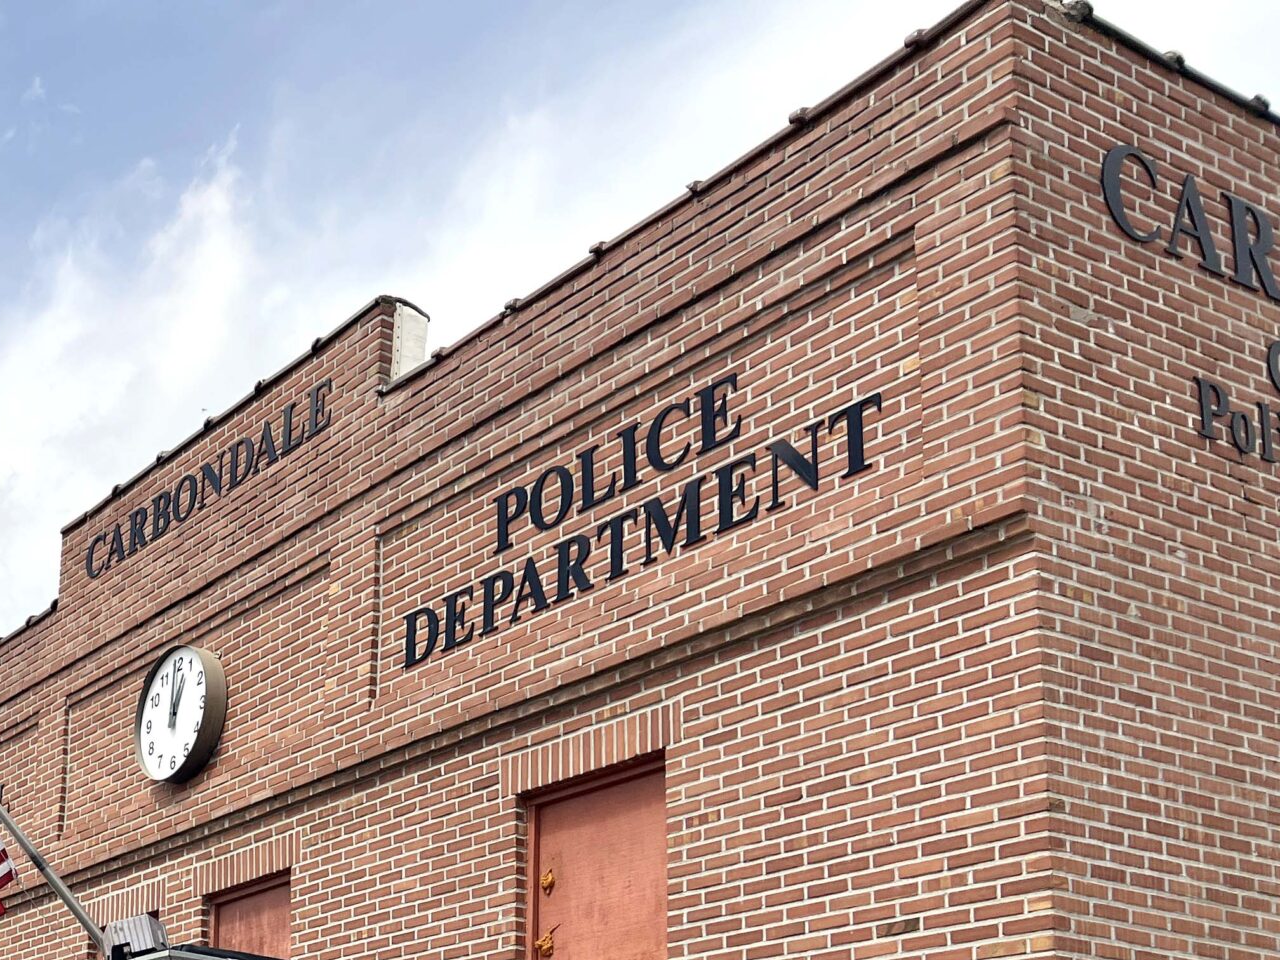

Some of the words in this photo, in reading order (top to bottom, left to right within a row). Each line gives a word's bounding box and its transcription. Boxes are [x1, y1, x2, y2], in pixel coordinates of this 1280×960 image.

[1193, 376, 1280, 463] Pol
[493, 372, 742, 555] POLICE
[85, 377, 333, 579] CARBONDALE
[402, 393, 883, 669] DEPARTMENT
[160, 672, 169, 688] 11
[150, 693, 160, 709] 10
[146, 720, 152, 734] 9
[148, 742, 155, 756] 8
[183, 743, 190, 758] 5
[157, 754, 163, 769] 7
[170, 755, 176, 770] 6
